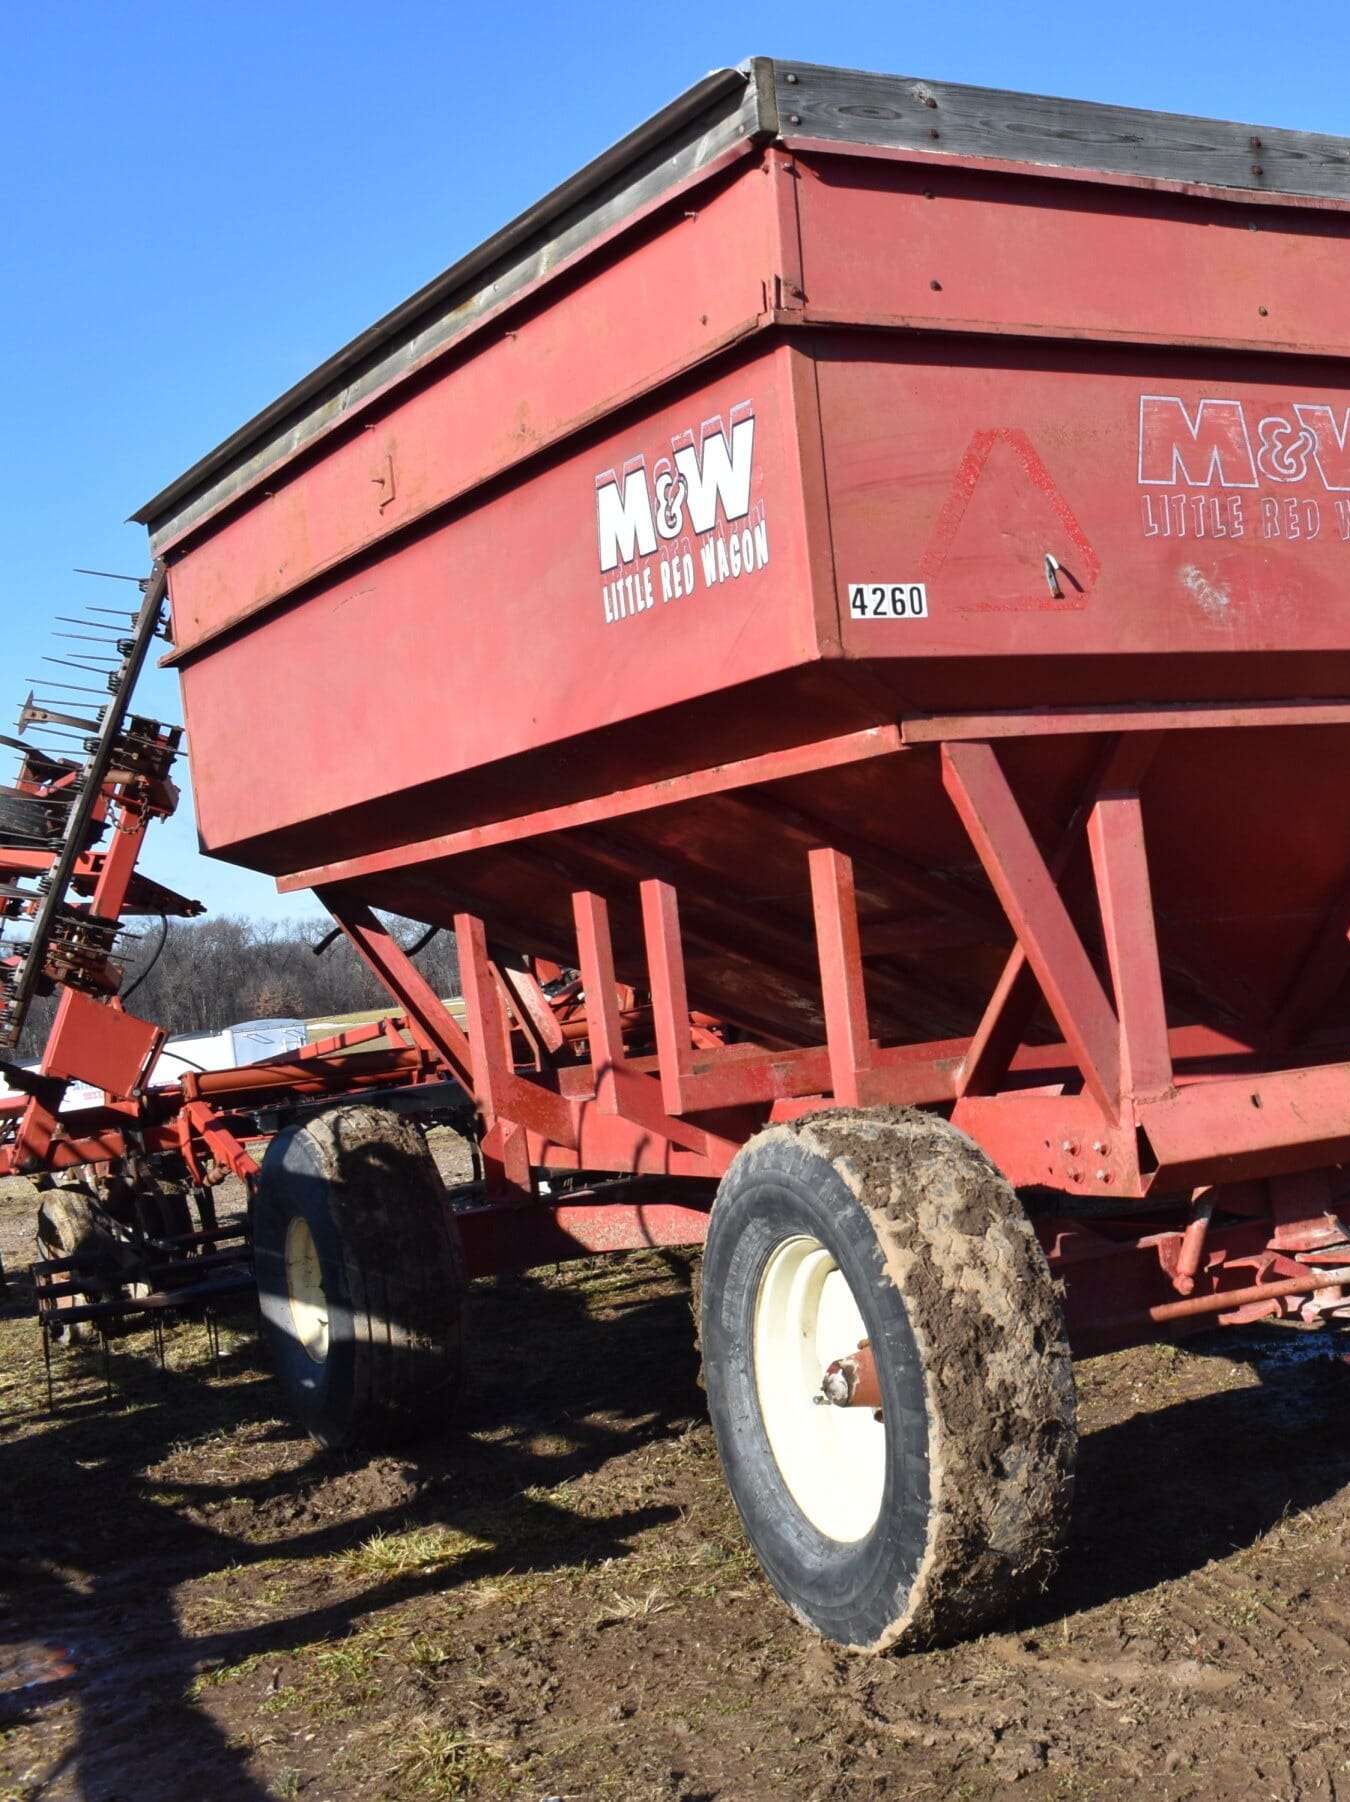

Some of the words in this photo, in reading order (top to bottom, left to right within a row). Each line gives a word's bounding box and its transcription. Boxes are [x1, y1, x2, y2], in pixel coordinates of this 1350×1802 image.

[596, 414, 755, 573] M&W
[1141, 494, 1245, 538] LITTLE
[1261, 496, 1321, 541] RED
[602, 566, 655, 624] LITTLE
[660, 552, 695, 603] RED
[701, 519, 769, 588] WAGON
[851, 586, 924, 616] 4260
